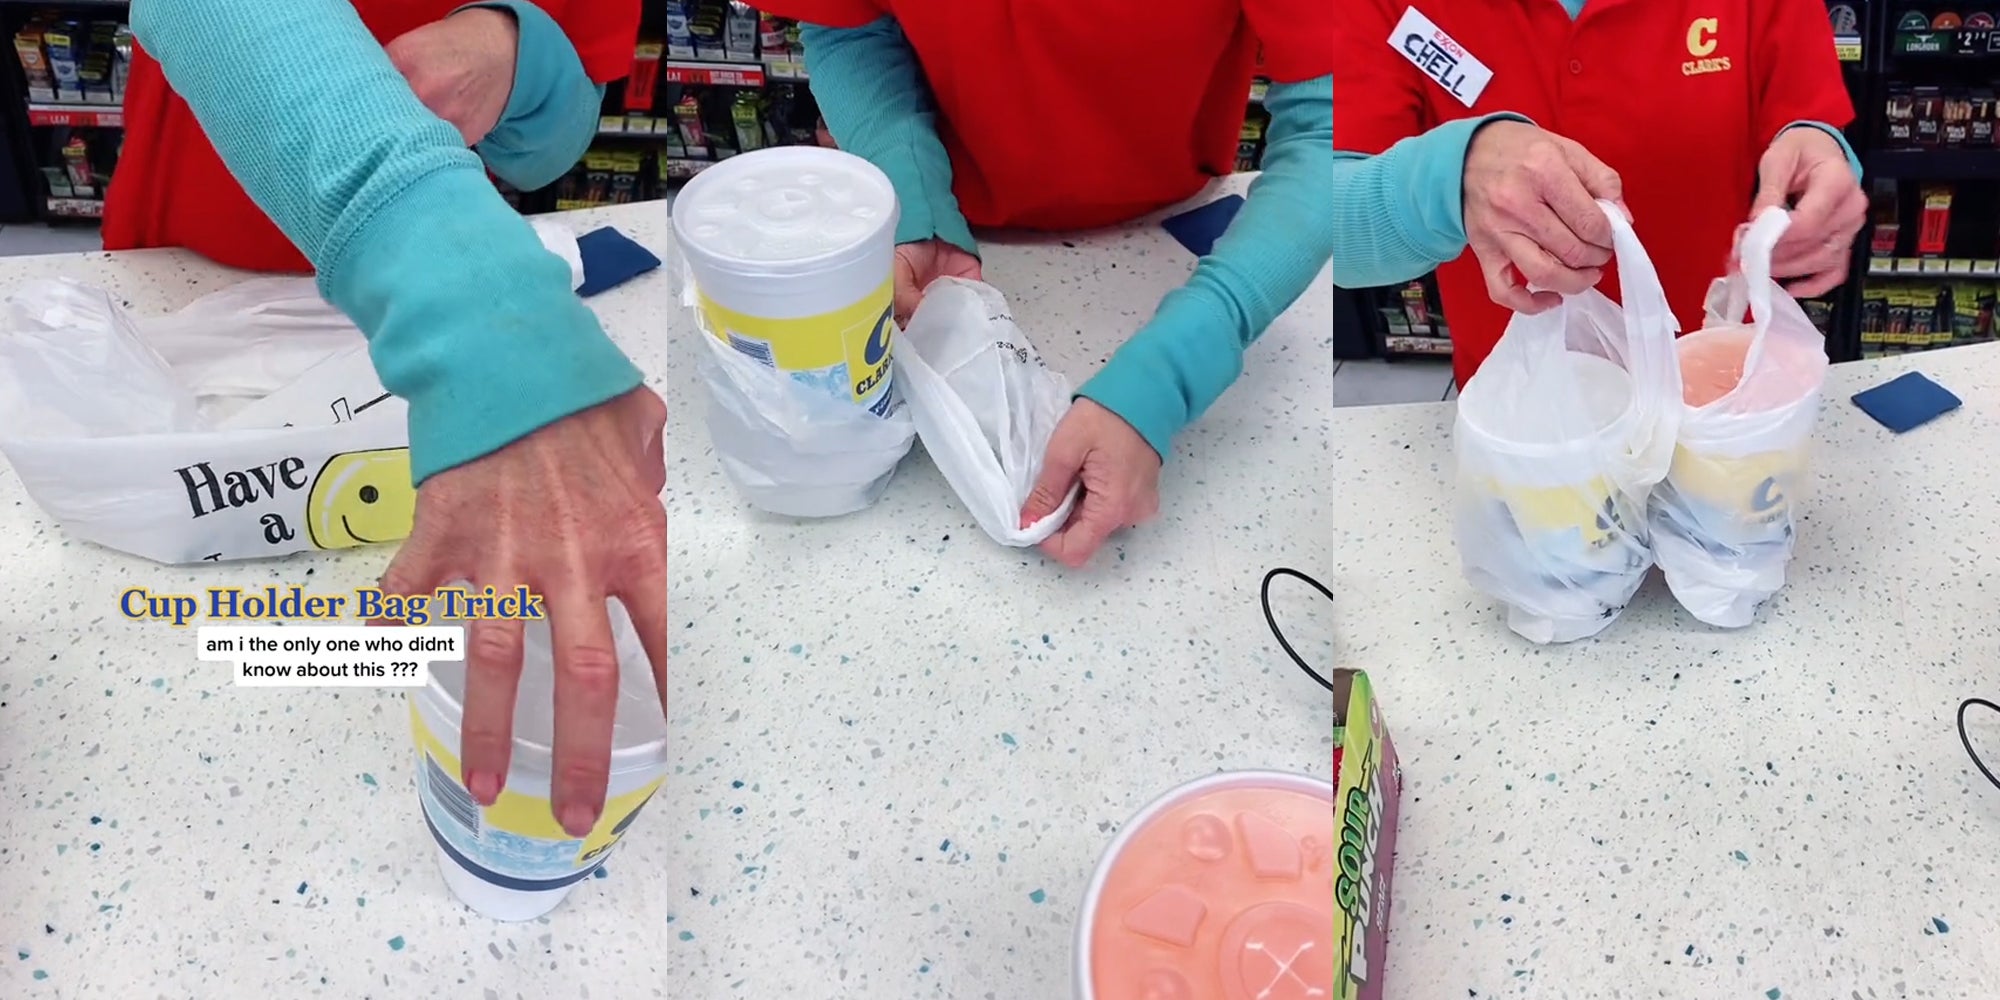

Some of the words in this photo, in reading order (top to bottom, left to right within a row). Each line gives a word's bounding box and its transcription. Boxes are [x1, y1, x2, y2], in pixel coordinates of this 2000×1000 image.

[1433, 30, 1464, 58] EXXON
[1686, 17, 1718, 57] C
[1906, 42, 1940, 52] LONGHORN
[1404, 33, 1466, 97] CHELL
[1682, 56, 1731, 76] CLARK'S
[173, 457, 308, 519] Have
[260, 513, 295, 545] a
[1336, 785, 1370, 918] SOUR
[1350, 764, 1384, 982] PUNCH
